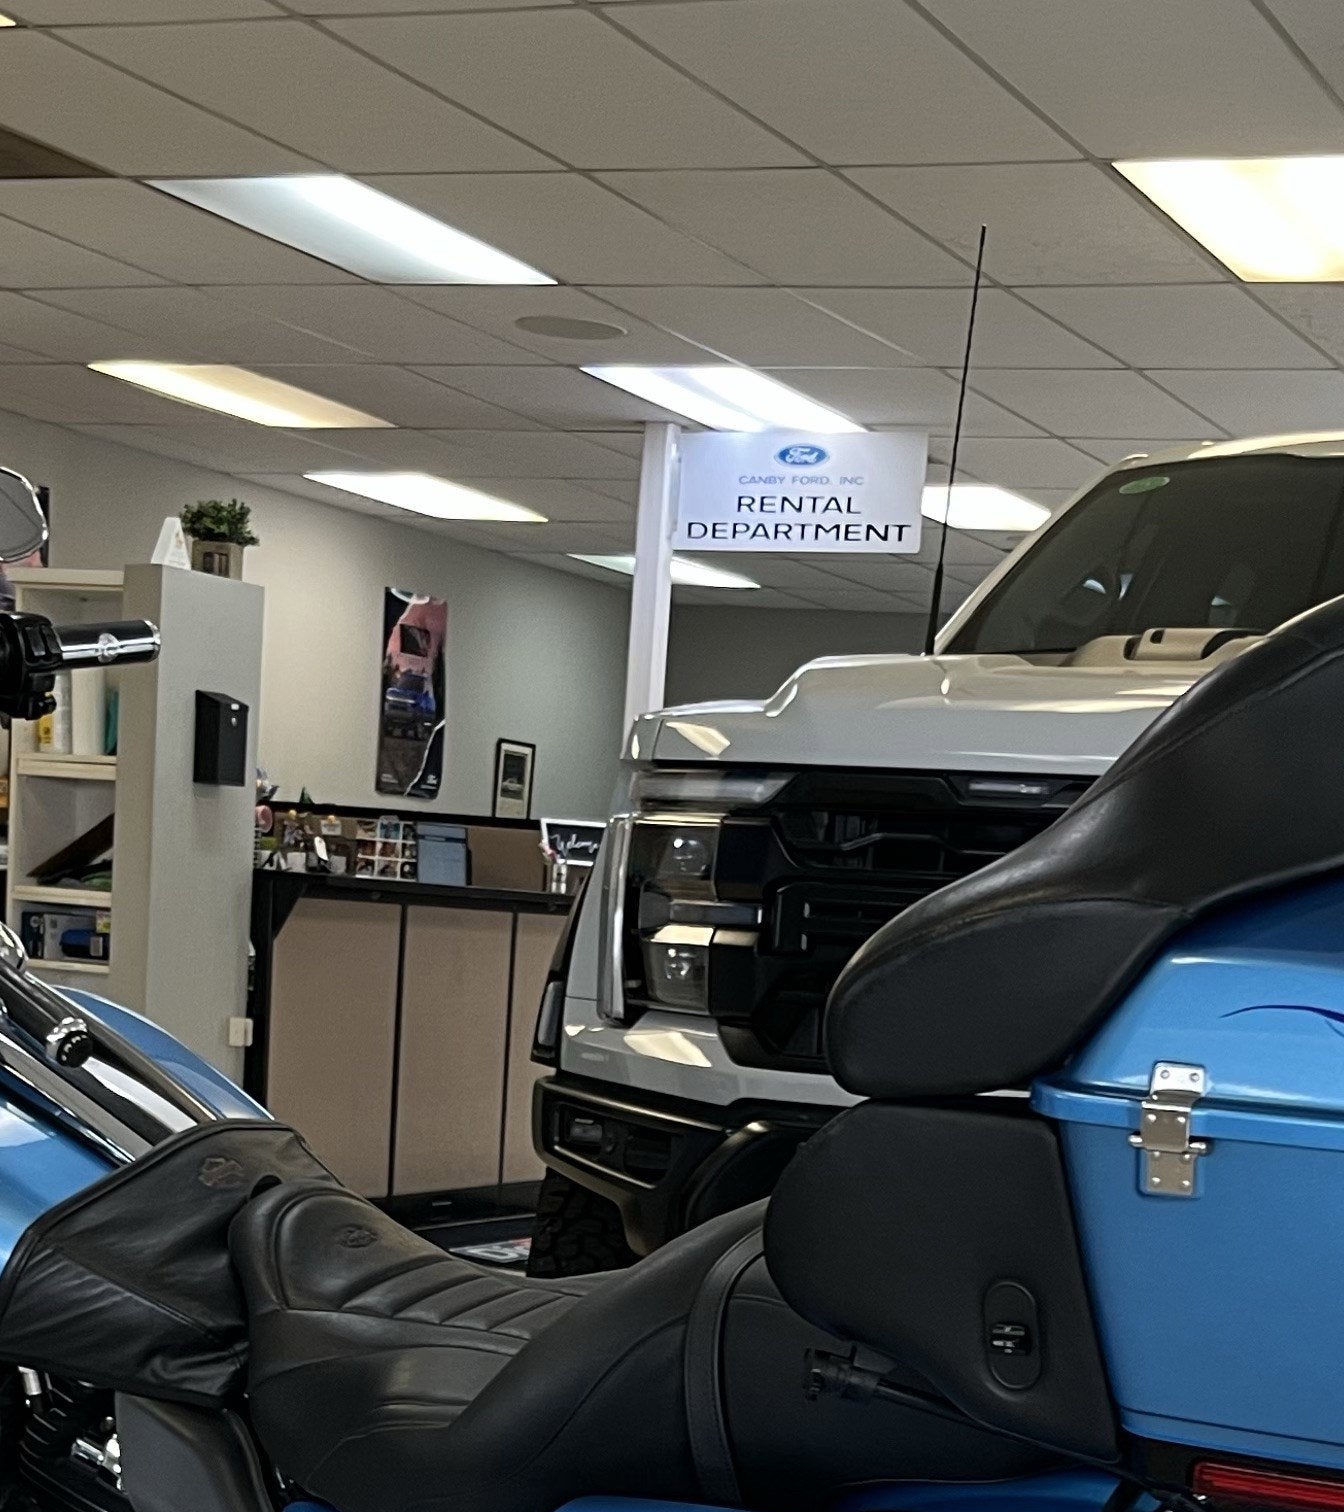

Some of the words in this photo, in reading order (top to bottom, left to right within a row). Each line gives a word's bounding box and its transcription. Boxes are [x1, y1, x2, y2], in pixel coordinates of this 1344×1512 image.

[785, 447, 819, 465] Ford
[738, 475, 785, 485] CANBY
[736, 495, 861, 514] RENTAL
[687, 521, 911, 542] DEPARTMENT
